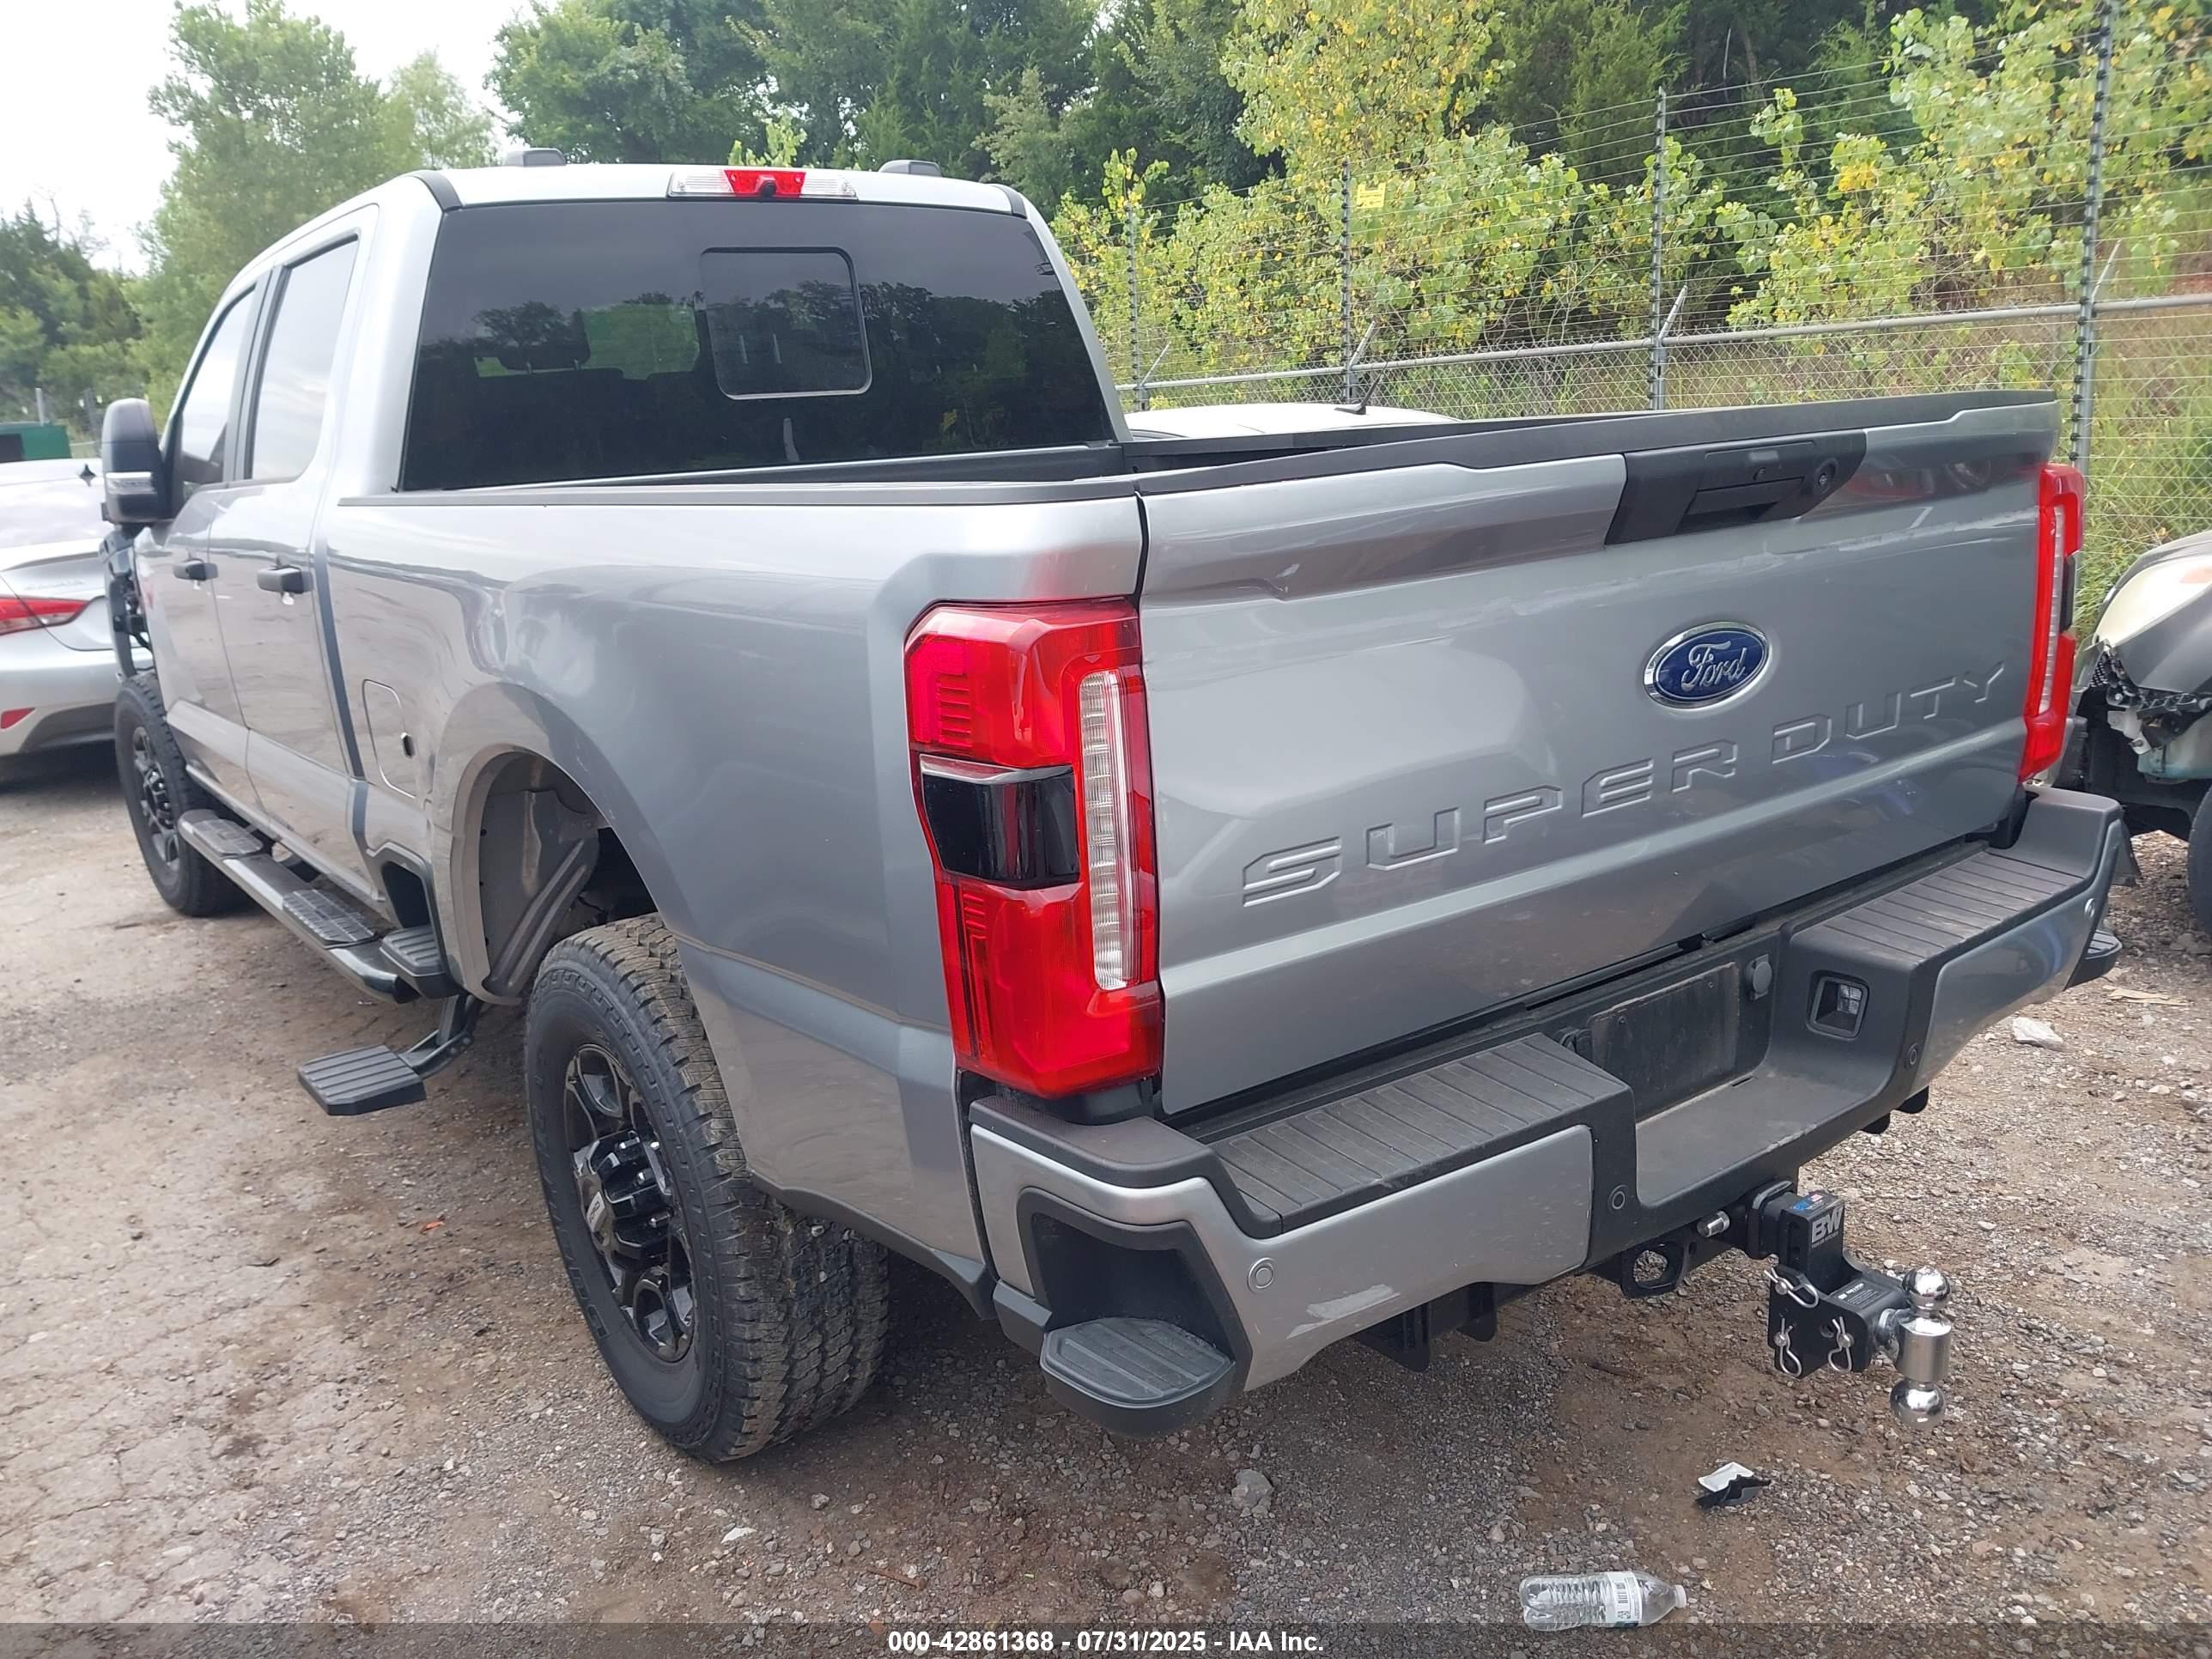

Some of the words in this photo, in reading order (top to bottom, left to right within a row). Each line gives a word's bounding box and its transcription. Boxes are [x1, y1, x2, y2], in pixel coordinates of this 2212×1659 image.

[1680, 640, 1747, 693] Ford
[1242, 738, 1737, 908] SUPER
[1771, 659, 2006, 766] DUTY
